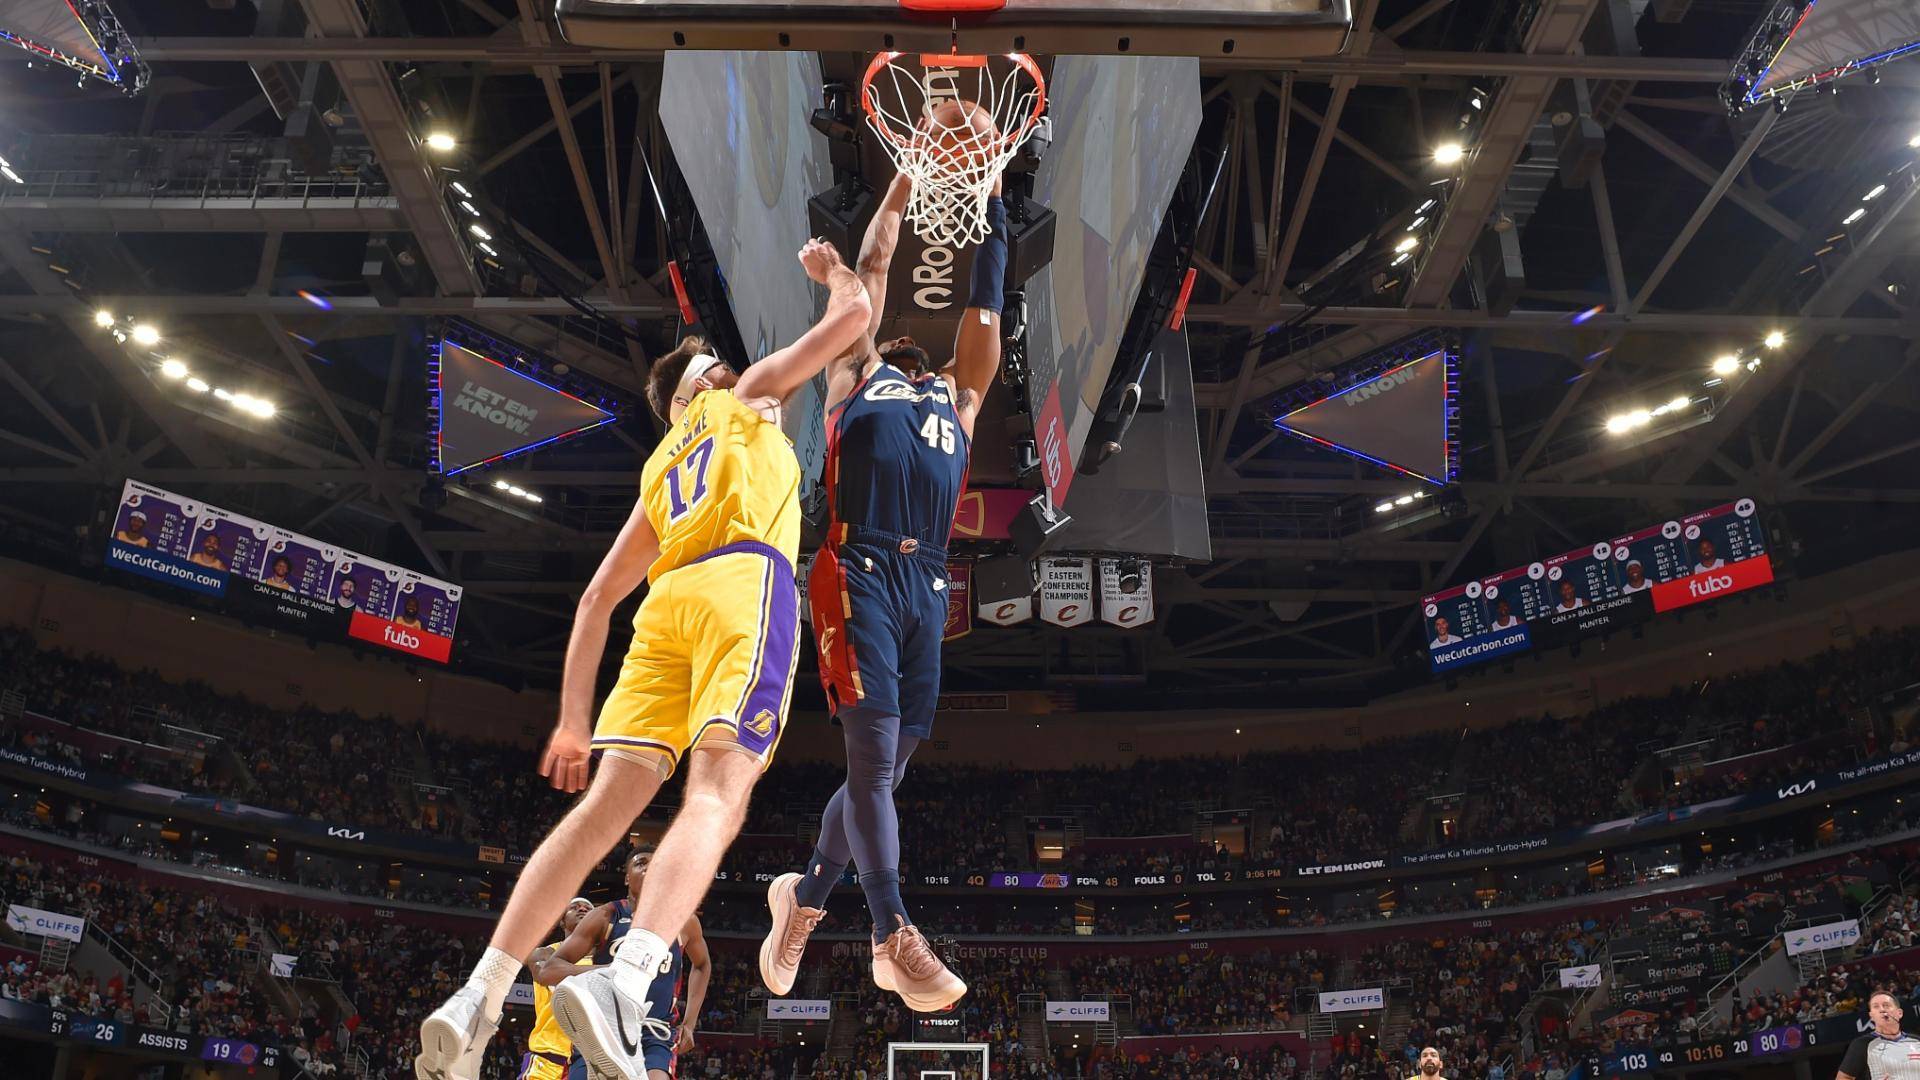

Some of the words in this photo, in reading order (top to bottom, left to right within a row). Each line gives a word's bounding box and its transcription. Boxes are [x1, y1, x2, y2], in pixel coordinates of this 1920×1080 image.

[460, 381, 500, 403] LET
[503, 400, 539, 421] EM
[666, 409, 708, 457] TIMME
[805, 397, 822, 467] CLIFFS
[921, 413, 955, 455] 45
[1043, 416, 1062, 488] fubo
[666, 436, 716, 522] 17
[1738, 503, 1751, 512] 45
[1665, 526, 1677, 534] 35
[325, 548, 334, 557] 11
[1596, 547, 1608, 555] 12
[112, 547, 222, 589] WeCutCarbon.com
[1533, 566, 1539, 574] 3
[1048, 572, 1083, 580] EASTERN
[253, 584, 270, 595] CAN
[1042, 581, 1090, 591] CONFERENCE
[1689, 574, 1733, 598] fubo
[449, 589, 458, 597] 23
[1044, 592, 1089, 601] CHAMPIONS
[277, 604, 308, 620] HUNTER
[1551, 615, 1566, 625] CAN
[1579, 616, 1610, 630] HUNTER
[384, 625, 420, 649] fubo
[1434, 632, 1526, 665] WeCutCarbon.com
[30, 756, 87, 781] Turbo-Hybrid
[1838, 770, 1855, 781] The
[1856, 762, 1889, 778] all-new
[1889, 757, 1905, 768] Kia
[1403, 855, 1418, 864] The
[1418, 852, 1447, 863] all-new
[1447, 849, 1460, 858] Kia
[1462, 845, 1495, 857] Telluride
[1495, 837, 1548, 855] Turbo-Hybrid
[1298, 866, 1323, 875] LET
[1324, 864, 1342, 873] EM
[1344, 859, 1386, 872] KNOW.
[735, 872, 743, 882] 2
[755, 873, 776, 882] FG%
[1197, 873, 1216, 882] TOL
[1224, 871, 1231, 881] 2
[1267, 869, 1281, 878] PM
[924, 875, 950, 885] 10:16
[967, 875, 985, 886] 4Q
[1004, 875, 1019, 886] 80
[1076, 877, 1099, 886] FG%
[1105, 876, 1118, 888] 48
[1134, 875, 1166, 886] FOULS
[1174, 874, 1182, 884] 0
[36, 918, 81, 935] CLIFFS
[1813, 928, 1857, 943] CLIFFS
[1008, 946, 1048, 959] CLUB
[516, 989, 533, 998] CLI
[1343, 994, 1381, 1005] CLIFFS
[791, 1005, 828, 1014] CLIFFS
[1070, 1007, 1107, 1015] CLIFFS
[52, 1011, 68, 1022] FG%
[51, 1022, 63, 1035] 51
[95, 1023, 115, 1041] 26
[138, 1033, 188, 1050] ASSISTS
[1759, 1035, 1778, 1052] 80
[1809, 1033, 1816, 1045] 0
[212, 1043, 230, 1059] 19
[265, 1046, 280, 1056] FG%
[1733, 1040, 1749, 1054] 20
[1659, 1051, 1673, 1064] 4Q
[1685, 1044, 1724, 1063] 10:16
[263, 1056, 274, 1068] 48
[1620, 1053, 1648, 1072] 103
[1592, 1065, 1599, 1076] 2
